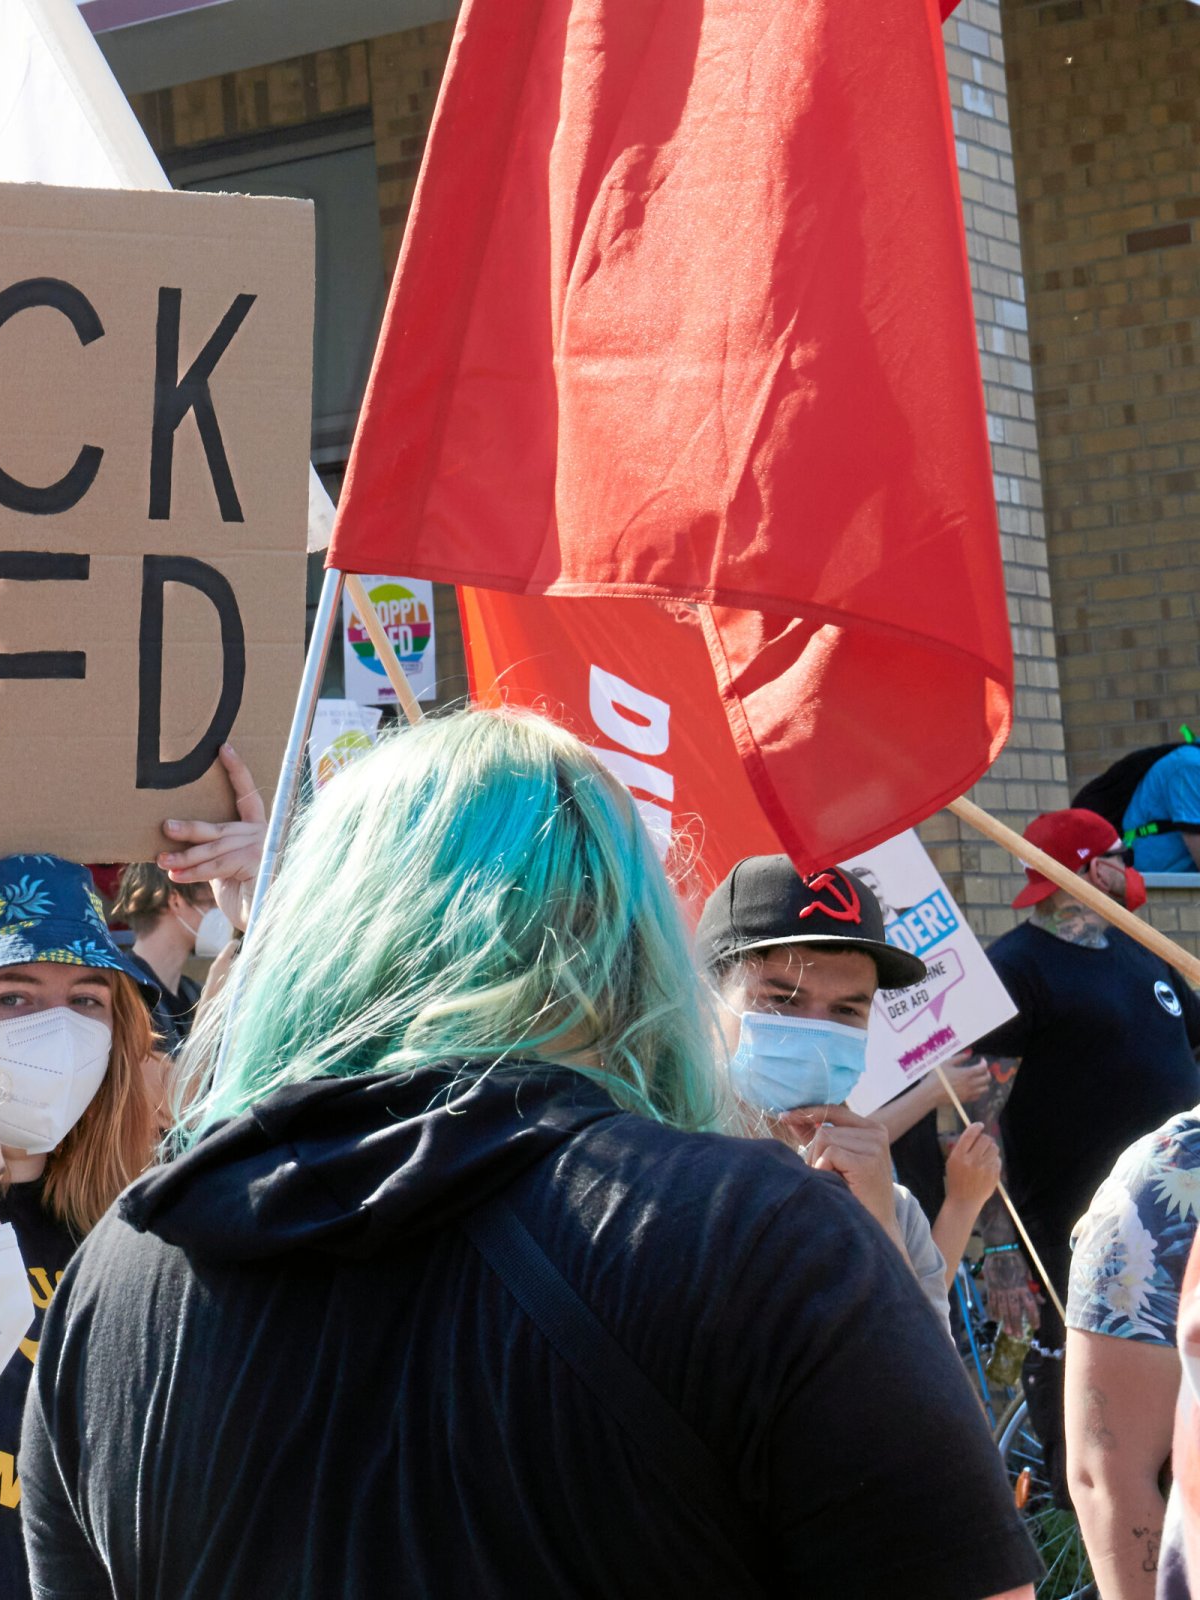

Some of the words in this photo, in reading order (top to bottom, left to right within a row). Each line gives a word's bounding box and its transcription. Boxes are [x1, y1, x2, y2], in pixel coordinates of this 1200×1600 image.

[352, 598, 423, 631] SOPPT
[373, 626, 414, 661] FD
[888, 894, 956, 957] DER!
[880, 984, 911, 1003] KEI
[915, 961, 947, 988] HNE
[887, 1000, 910, 1020] DER
[910, 988, 929, 1008] AFD
